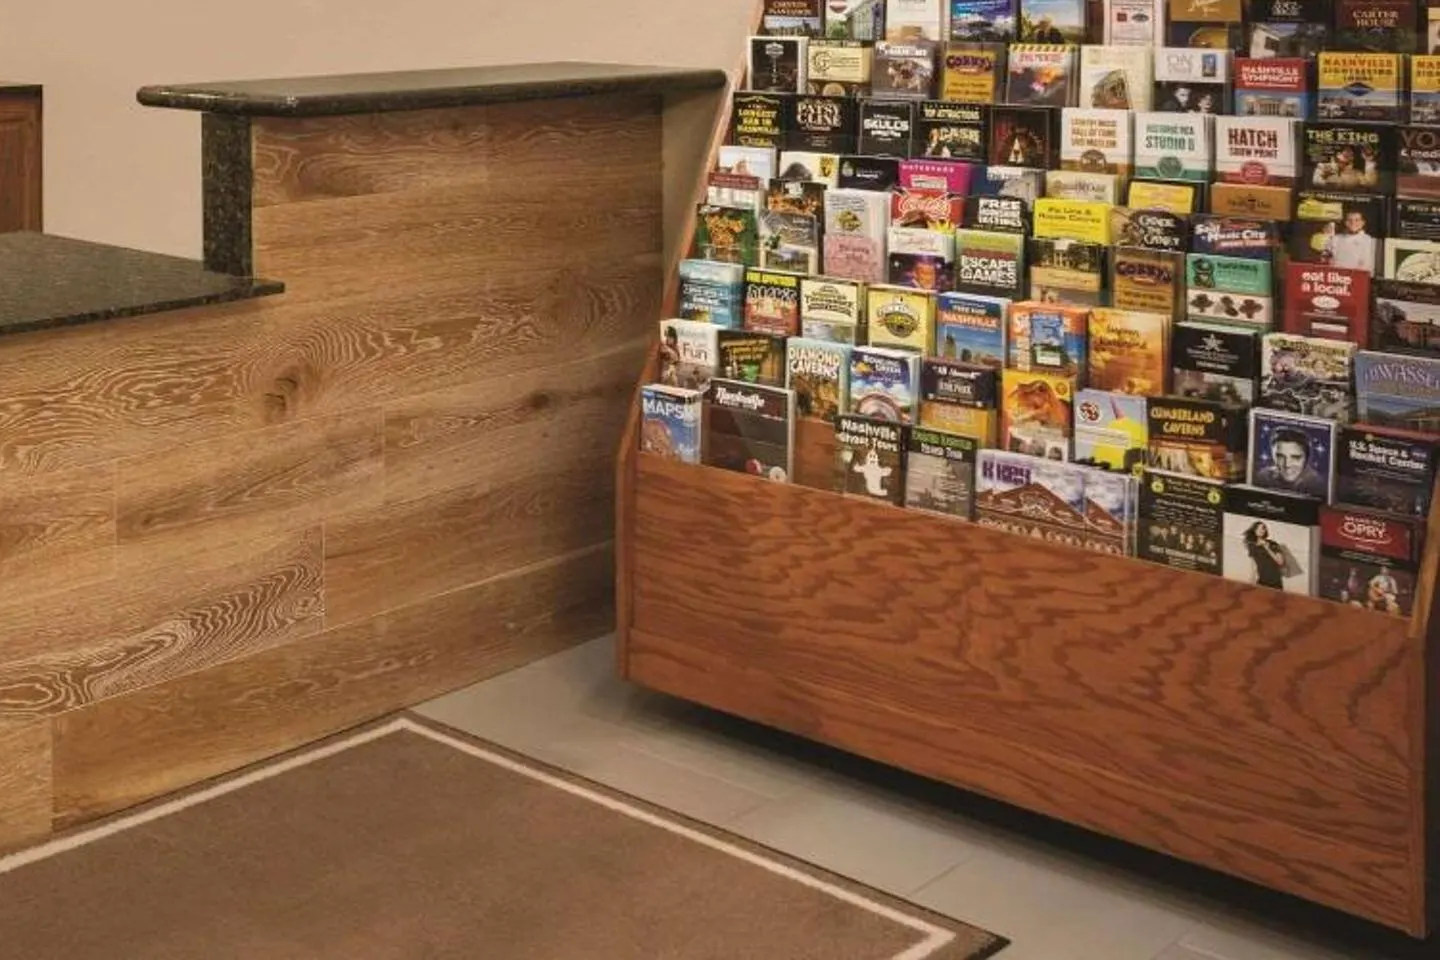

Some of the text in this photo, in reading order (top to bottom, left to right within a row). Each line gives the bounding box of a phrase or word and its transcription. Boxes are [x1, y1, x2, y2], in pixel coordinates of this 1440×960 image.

[1323, 57, 1393, 67] NASHVILLE
[1241, 65, 1299, 75] NASHVILLE
[1241, 74, 1300, 83] SYMPHONY
[1145, 136, 1186, 150] STUDIO
[1228, 127, 1277, 148] HATCH
[1306, 130, 1379, 144] THE KING
[978, 198, 1021, 210] FREE
[1241, 230, 1267, 241] City
[960, 255, 1017, 272] ESCAPE
[960, 268, 1017, 284] GAMES
[1301, 271, 1352, 285] eat like
[1301, 282, 1351, 296] a local.
[942, 312, 998, 328] NASHVILLE
[682, 343, 708, 361] Fun
[788, 347, 841, 367] DIAMOND
[789, 360, 838, 379] CAVERNS
[1150, 406, 1215, 423] CUMBERLAND
[841, 419, 898, 440] Nashville
[1162, 422, 1206, 436] CAVERNS
[871, 437, 898, 452] Tours
[1369, 443, 1399, 457] Space
[1348, 449, 1426, 470] Rocket Center
[1343, 521, 1386, 538] OPRY
